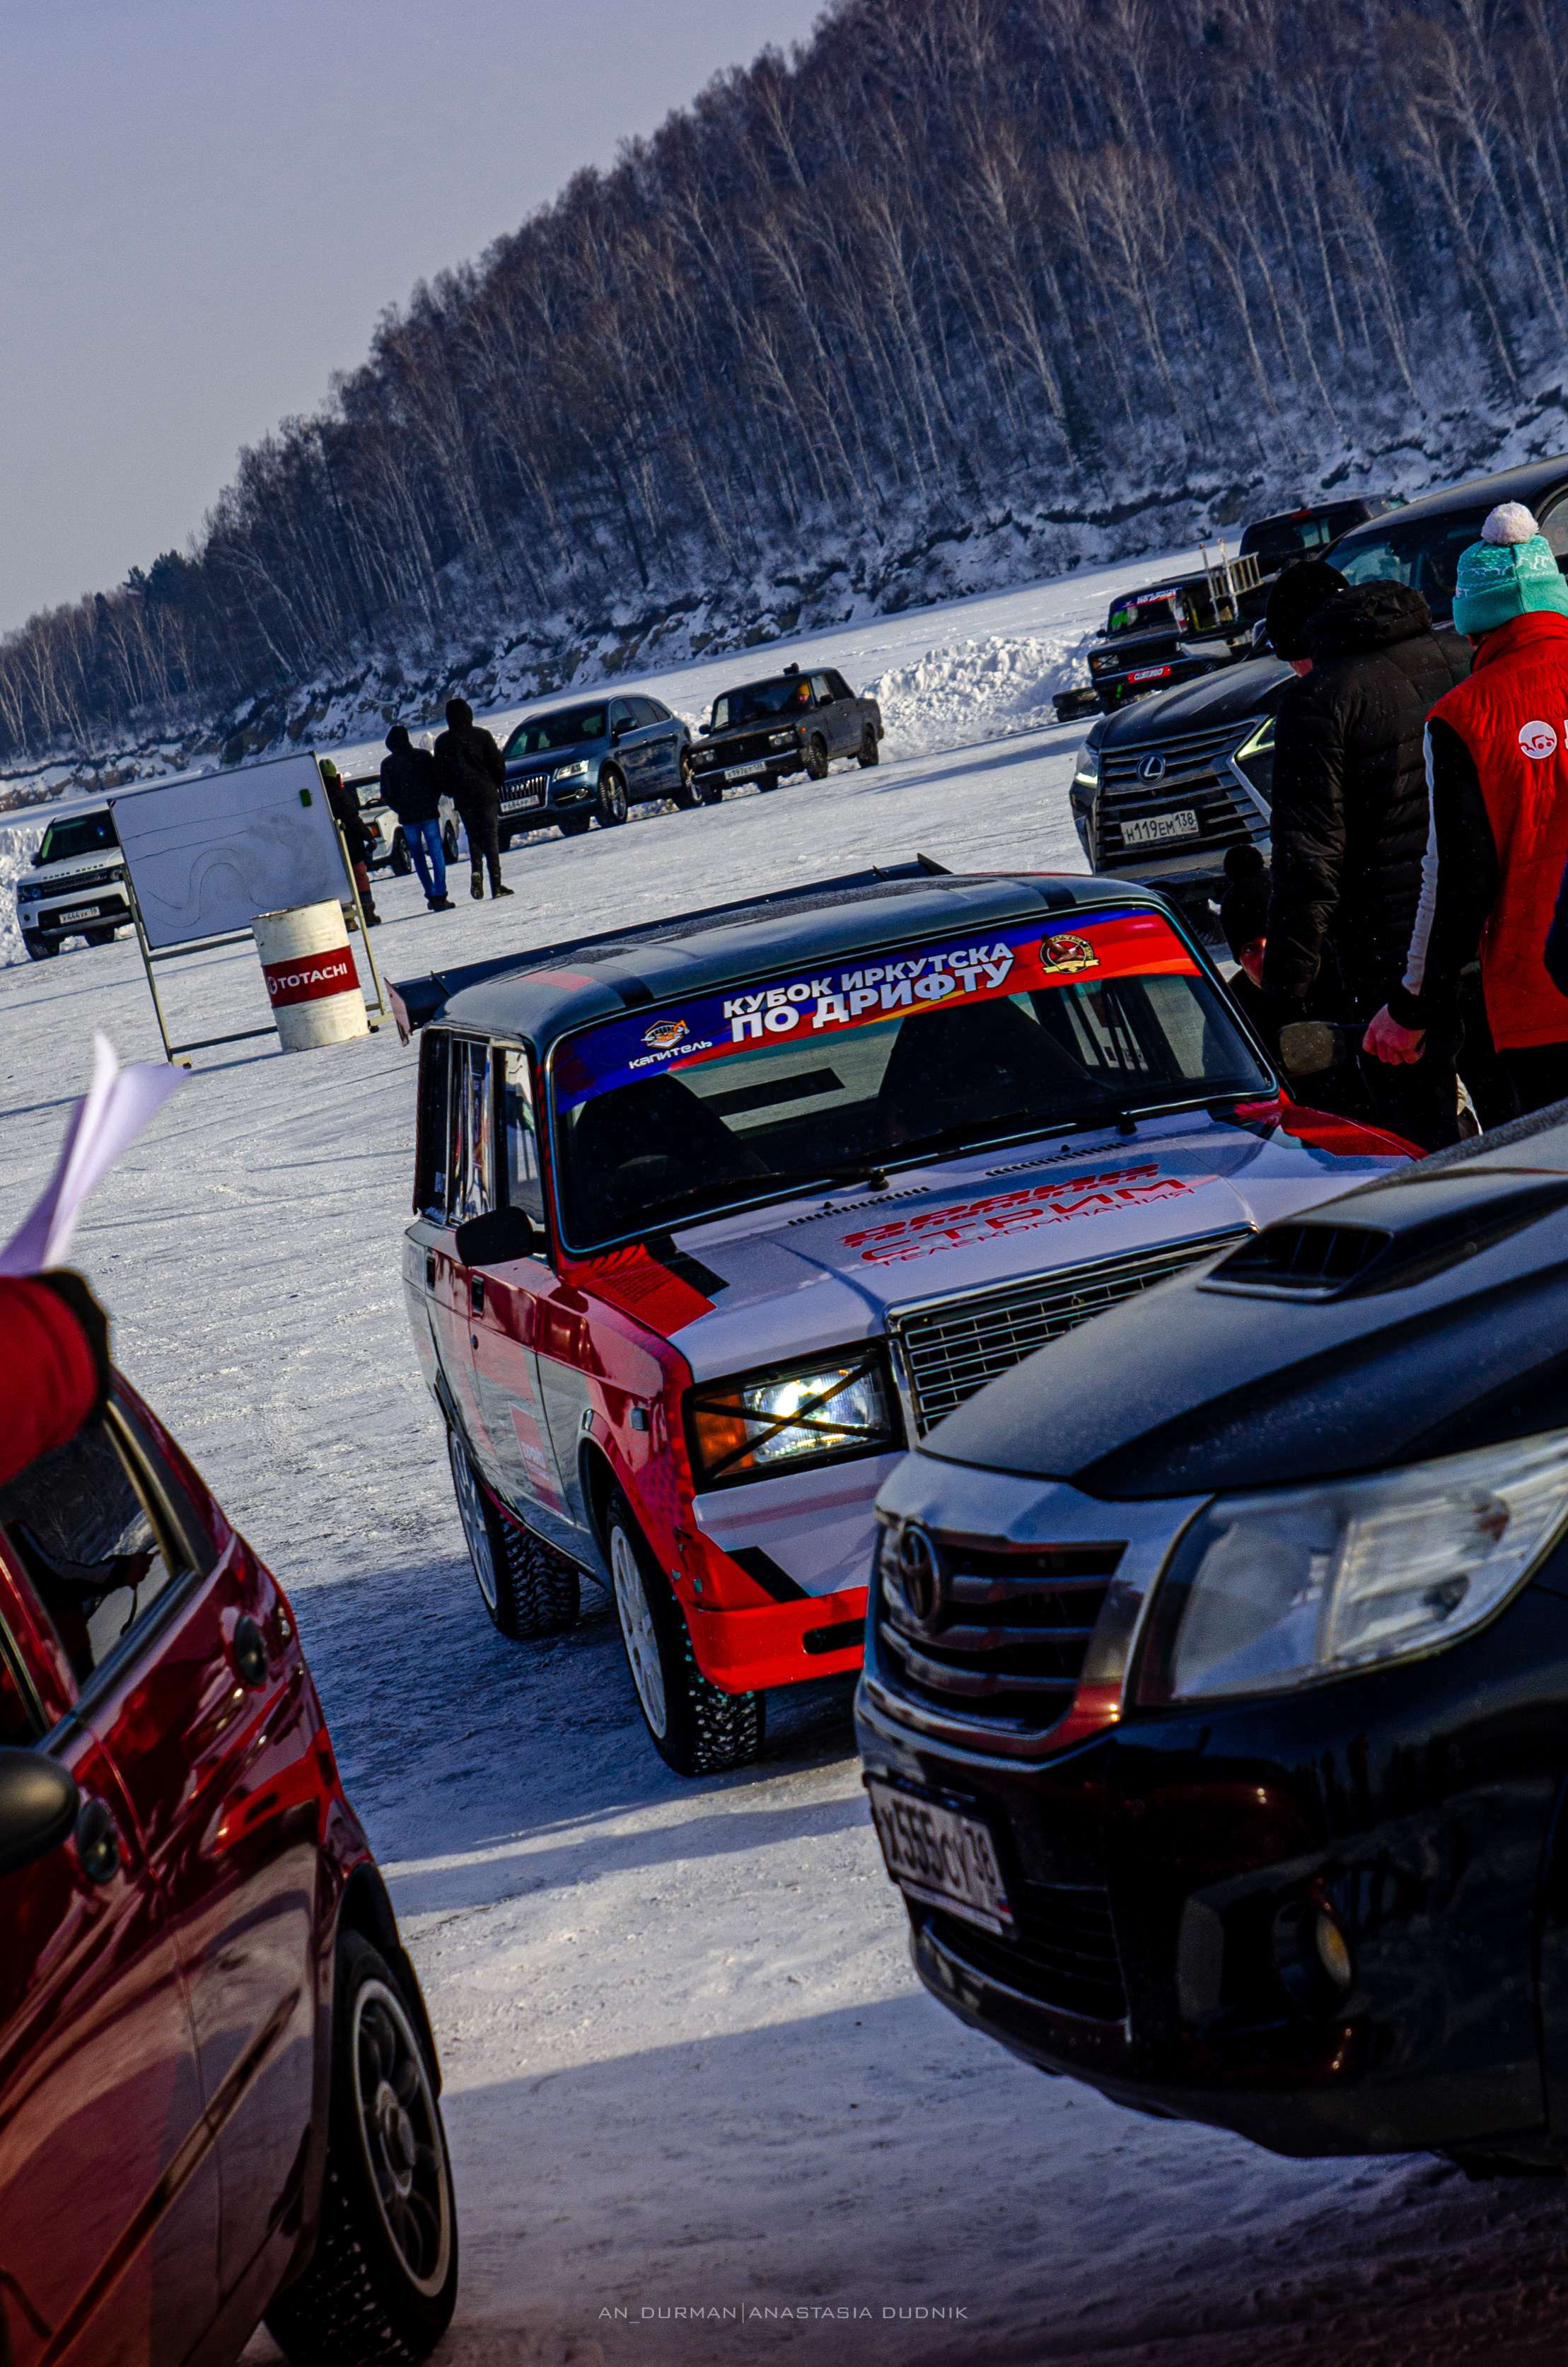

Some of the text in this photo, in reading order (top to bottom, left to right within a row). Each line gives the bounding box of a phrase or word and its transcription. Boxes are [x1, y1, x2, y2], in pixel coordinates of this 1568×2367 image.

[1125, 812, 1195, 842] Н119ЕМ 138
[43, 863, 103, 880] RANGE ROVER
[277, 962, 347, 989] TOTACHI
[724, 977, 833, 1019] КУБОК
[841, 942, 1015, 991] ИРКУТСКА
[731, 958, 1014, 1043] ПО ДРИФТУ
[861, 1178, 1187, 1262] СТРИМ
[874, 1187, 1195, 1267] ТЕЛЕКОМПАНИЯ
